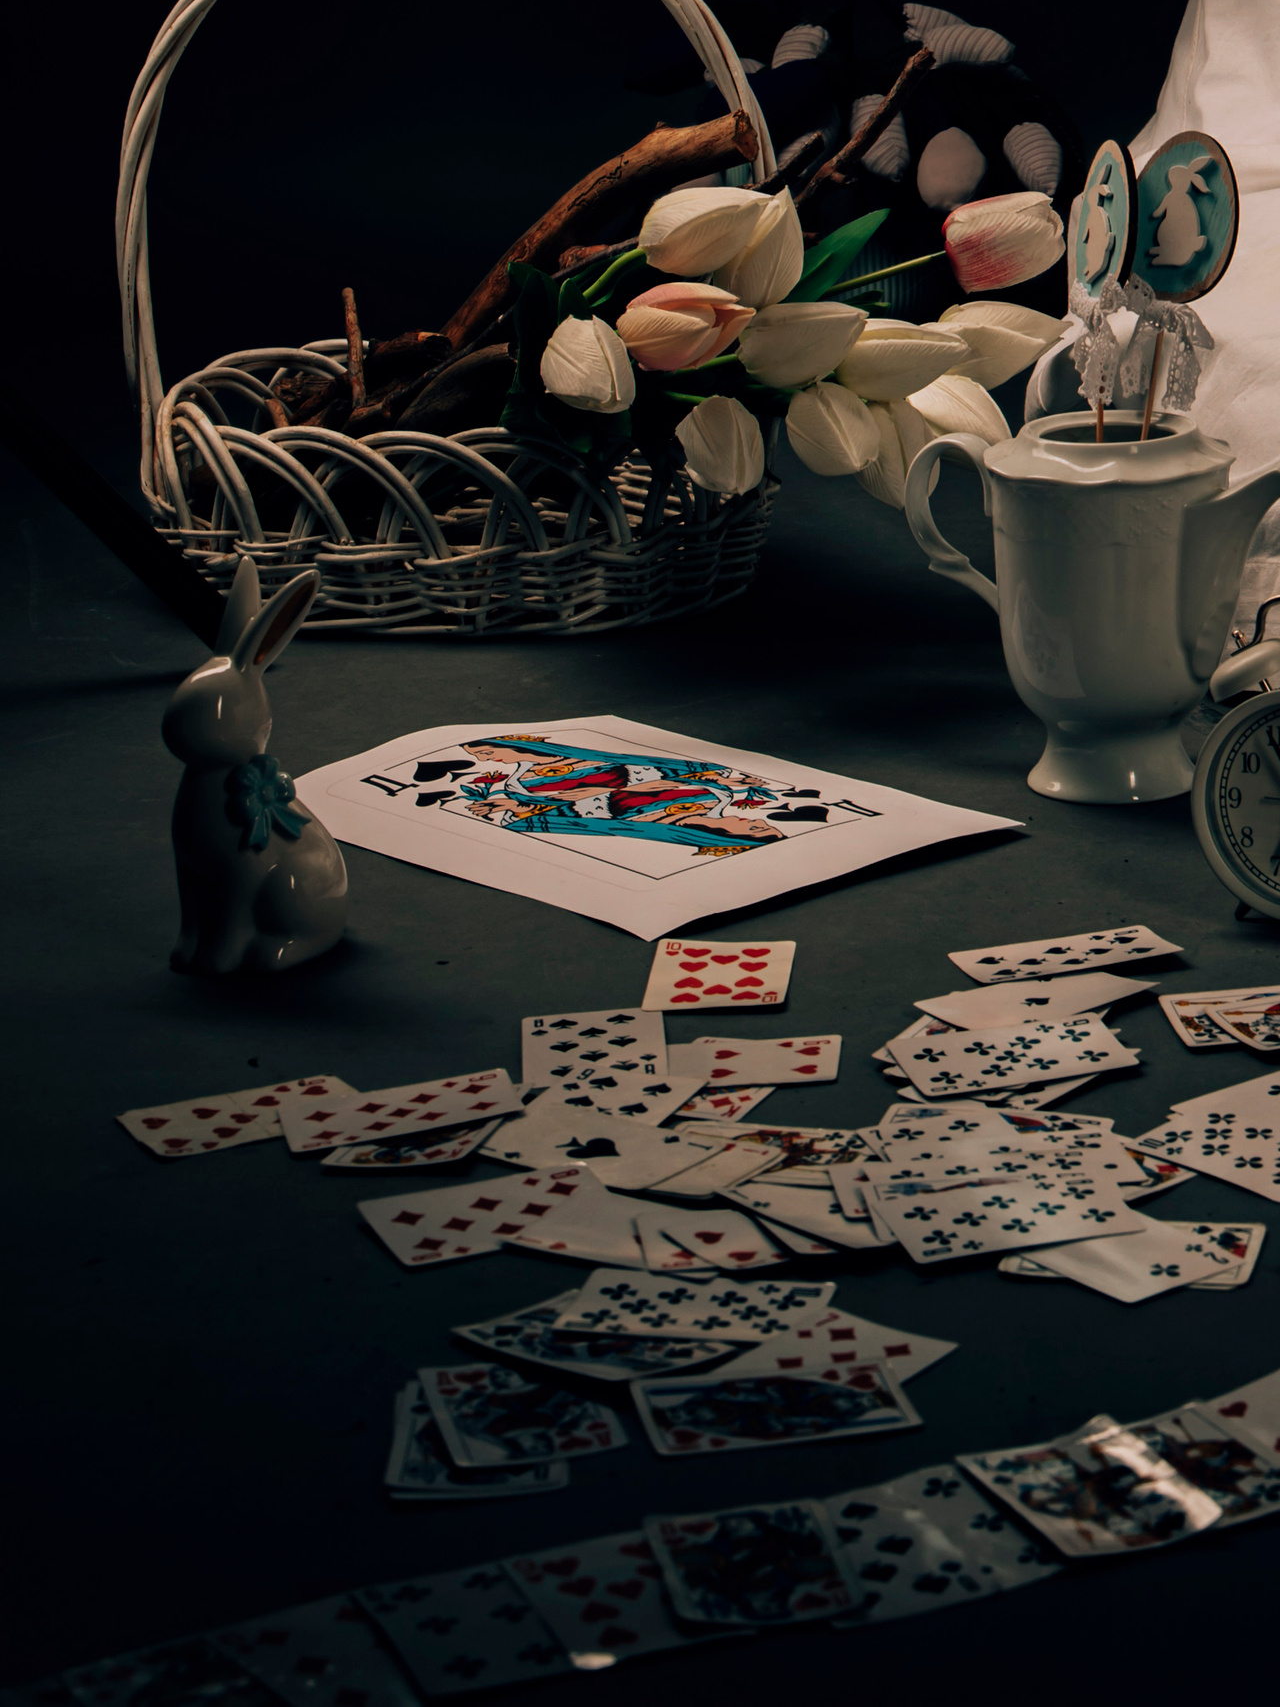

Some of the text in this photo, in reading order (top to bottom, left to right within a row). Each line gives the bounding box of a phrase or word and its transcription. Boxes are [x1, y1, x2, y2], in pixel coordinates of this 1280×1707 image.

[1241, 752, 1260, 774] 10
[1228, 787, 1242, 808] 9
[1240, 826, 1254, 848] 8
[666, 942, 682, 950] 10
[576, 1068, 595, 1080] 9
[1138, 1138, 1165, 1149] 10
